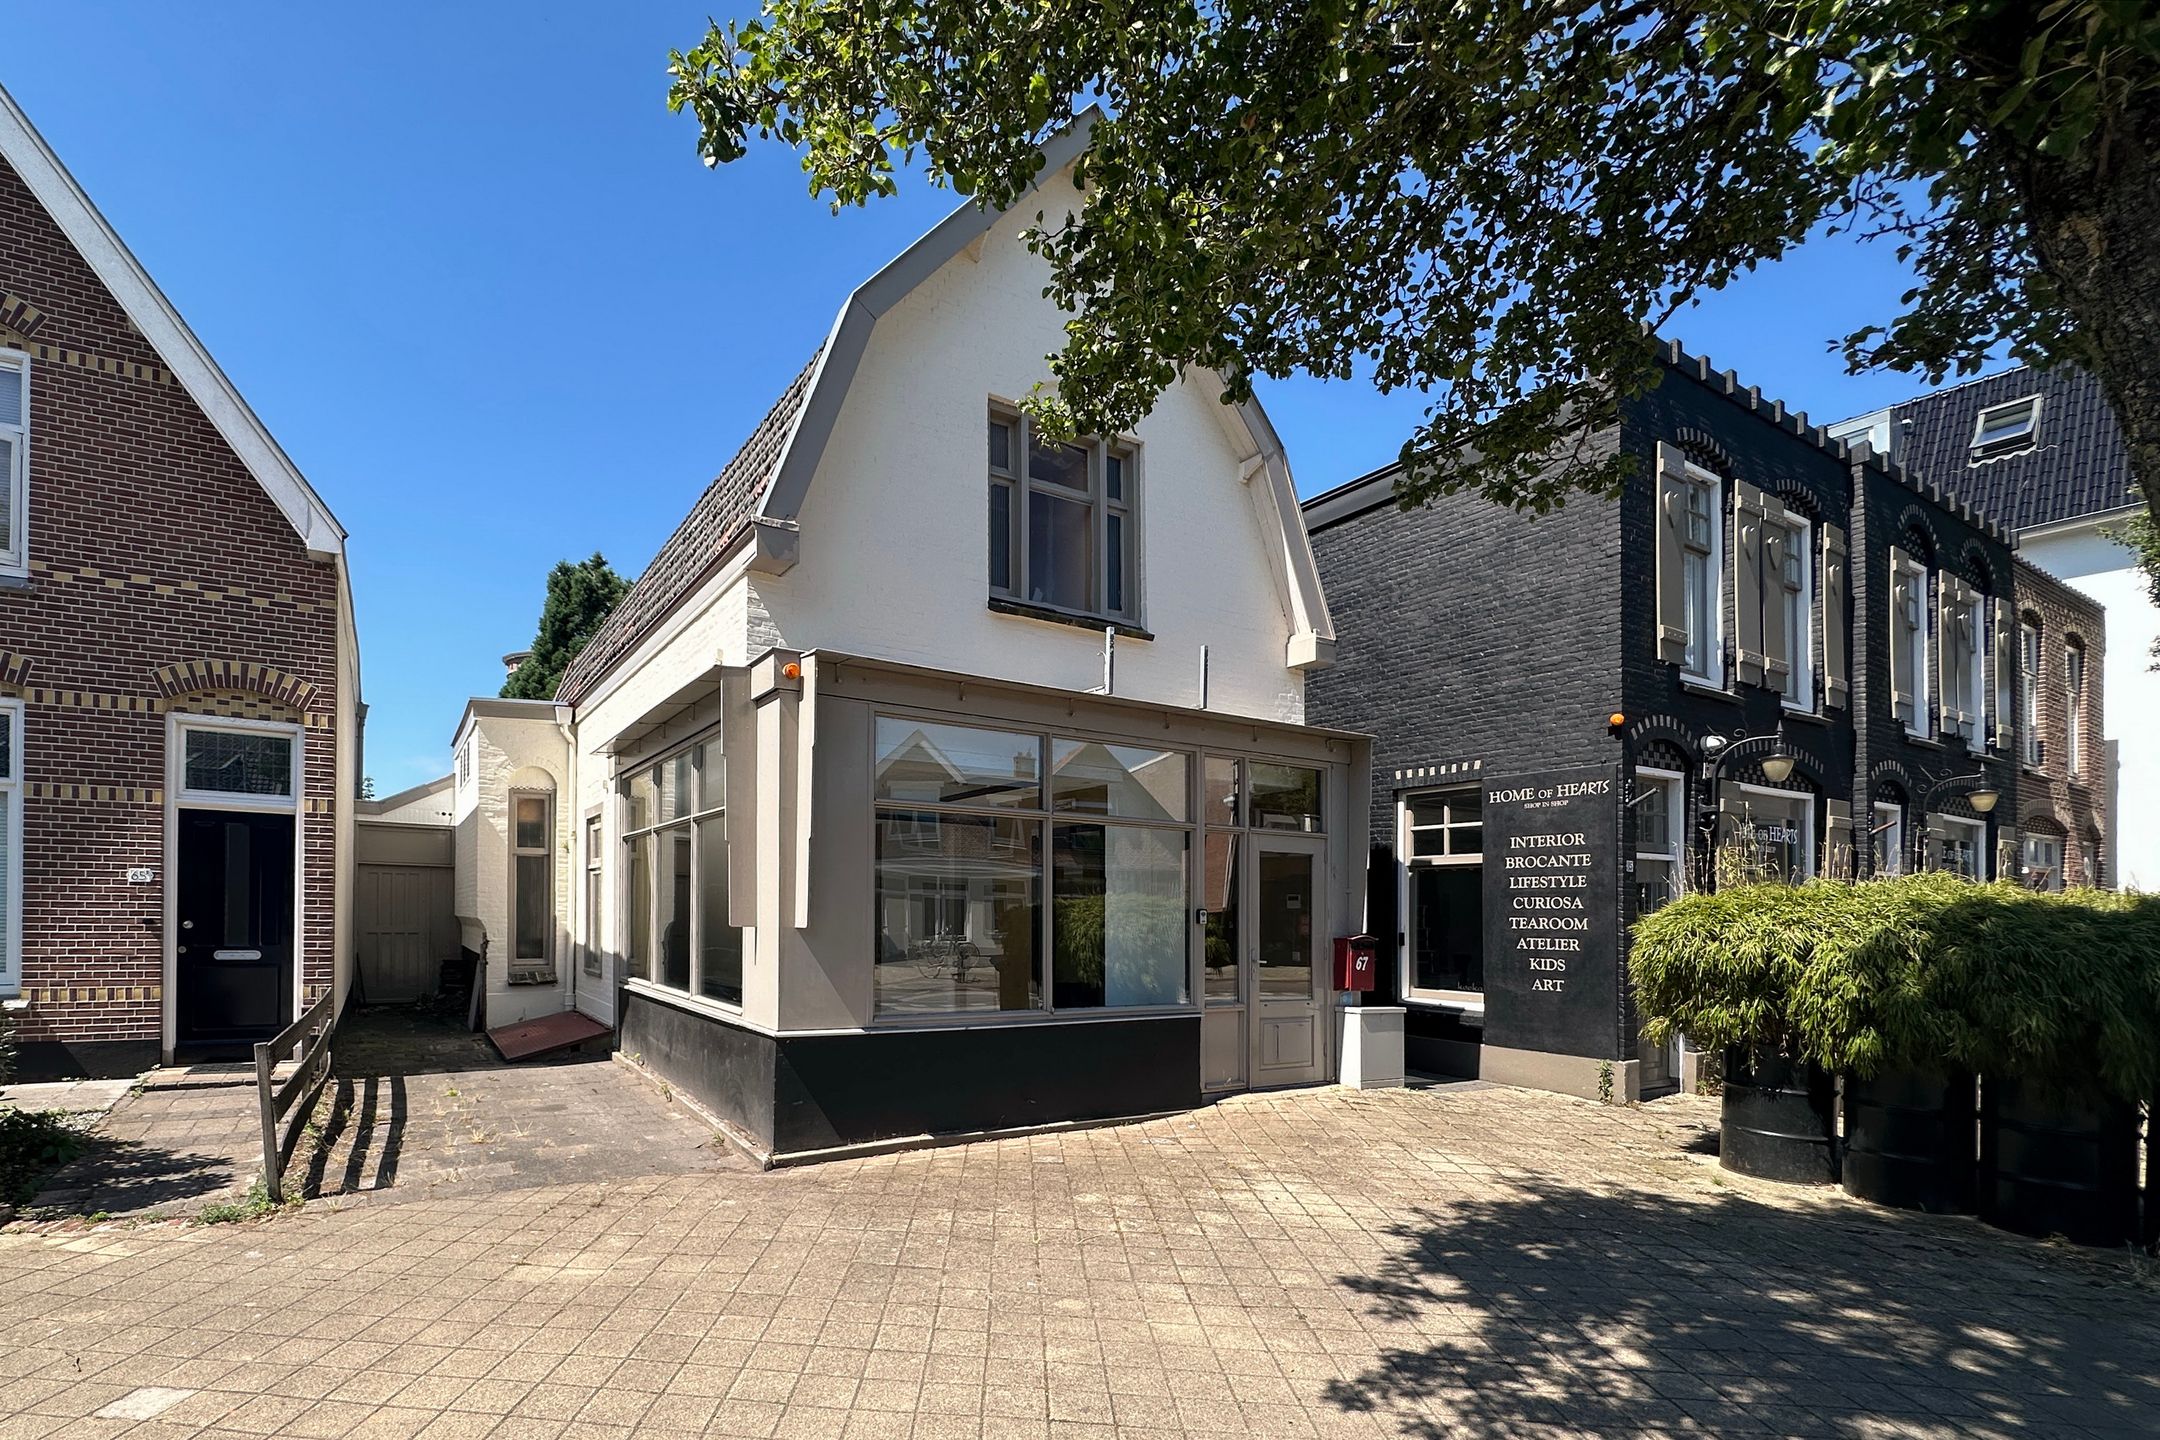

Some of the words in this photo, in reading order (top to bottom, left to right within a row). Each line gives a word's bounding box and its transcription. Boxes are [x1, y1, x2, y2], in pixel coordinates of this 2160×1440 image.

[1489, 788, 1535, 803] HOME
[1538, 789, 1553, 799] OF
[1556, 780, 1610, 798] HEARTS
[1510, 833, 1586, 849] INTERIOR
[1769, 825, 1798, 845] HEARTS
[1505, 853, 1592, 869] BROCANTE
[1509, 875, 1587, 889] LIFESTYLE
[1513, 896, 1584, 909] CURIOSA
[1509, 917, 1588, 930] TEAROOM
[1516, 937, 1580, 951] ATELIER
[1355, 956, 1369, 971] 67
[1529, 958, 1566, 971] KIDS
[1532, 978, 1565, 992] ART
